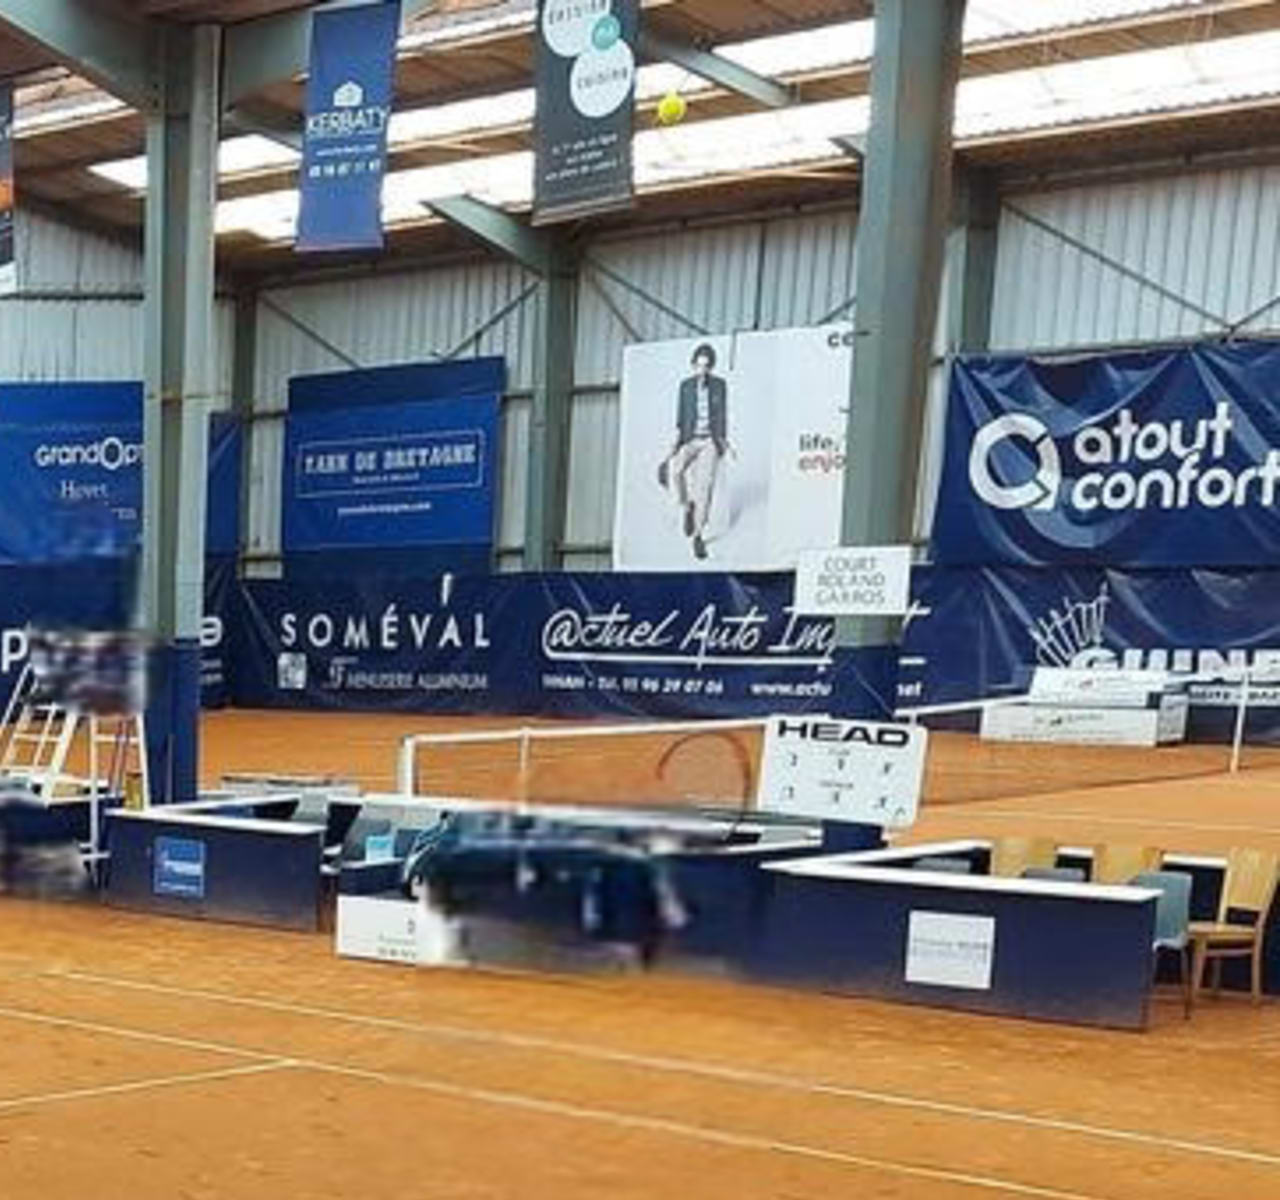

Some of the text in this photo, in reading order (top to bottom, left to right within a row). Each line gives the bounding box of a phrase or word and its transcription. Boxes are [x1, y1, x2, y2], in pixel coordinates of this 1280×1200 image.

[34, 437, 145, 470] GrandOp
[1074, 402, 1233, 462] atout
[1073, 448, 1280, 509] confort
[280, 602, 491, 649] SOMÉVAL
[681, 602, 769, 654] Auto
[777, 720, 910, 748] HEAD
